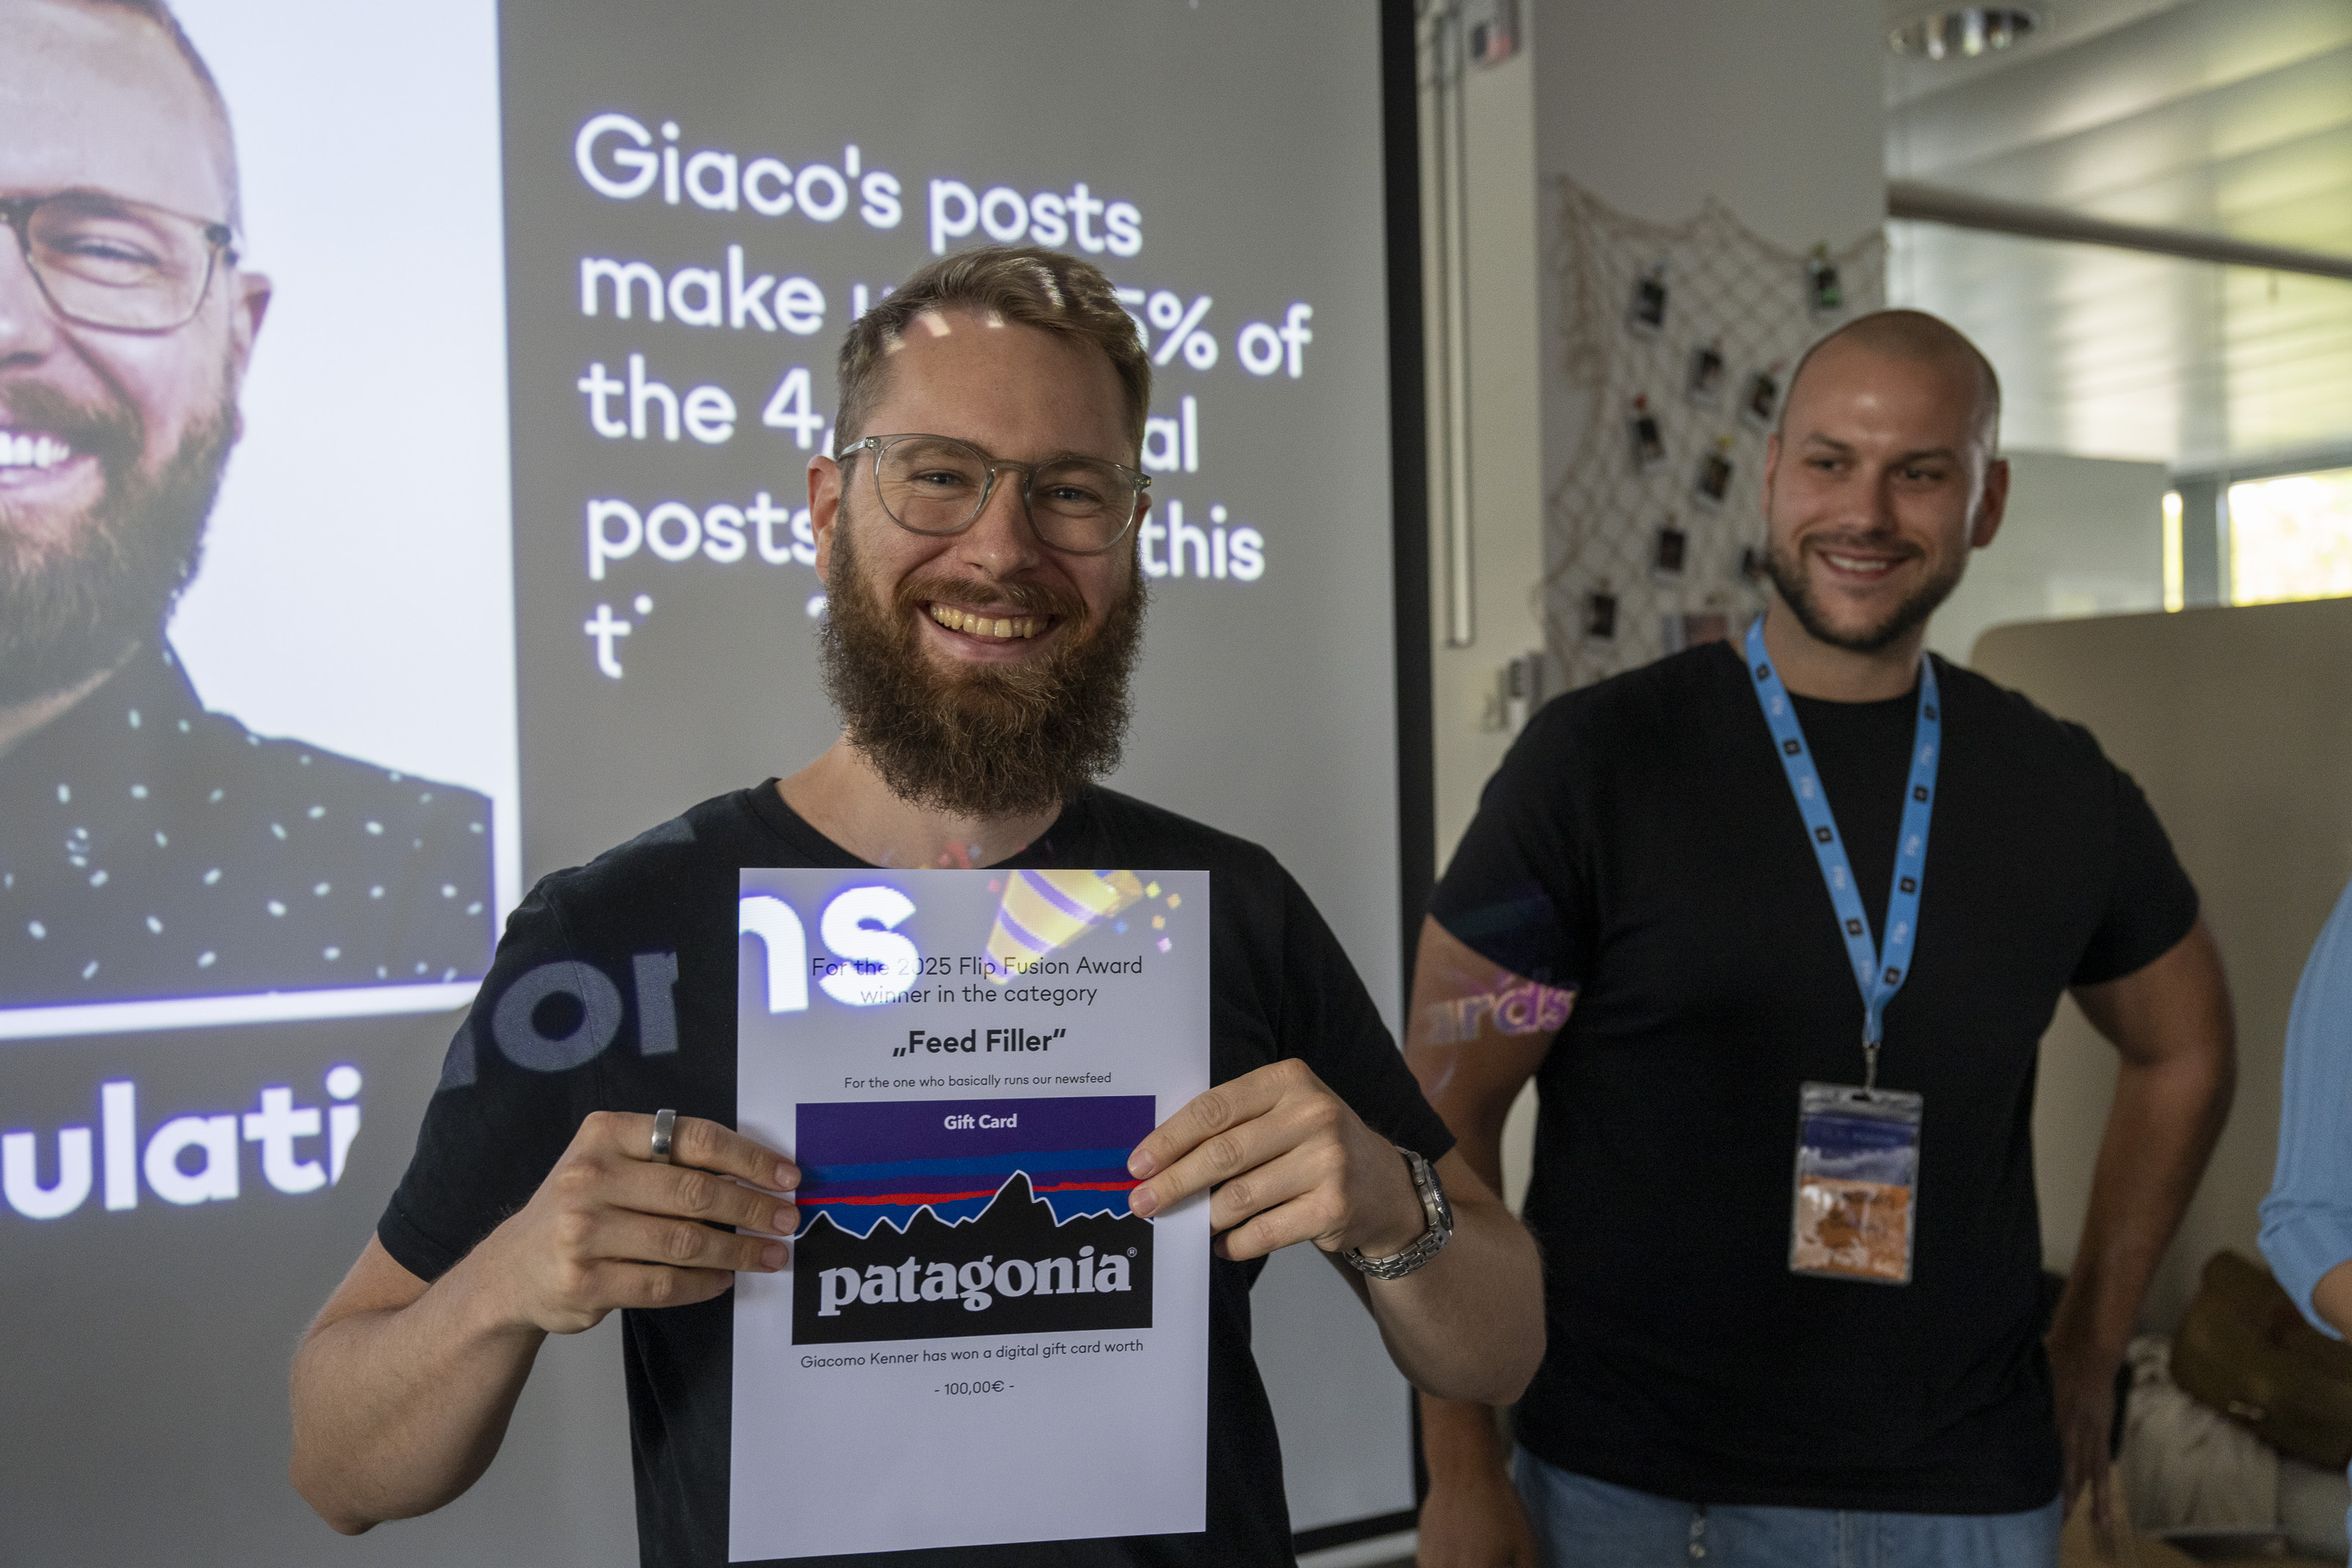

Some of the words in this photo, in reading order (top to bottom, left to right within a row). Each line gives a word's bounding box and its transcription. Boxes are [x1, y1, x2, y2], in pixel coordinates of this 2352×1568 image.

[574, 112, 904, 230] Giaco's
[928, 178, 1144, 258] posts
[579, 243, 827, 336] make
[1237, 302, 1314, 379] of
[577, 353, 736, 444] the
[586, 491, 818, 582] posts
[1139, 499, 1266, 582] this
[812, 957, 848, 976] For
[853, 957, 890, 976] the
[959, 956, 996, 980] Flip
[1003, 956, 1070, 975] Fusion
[1076, 955, 1143, 975] Award
[860, 984, 931, 1003] winner
[938, 984, 955, 1002] in
[961, 983, 997, 1002] the
[1004, 985, 1098, 1007] category
[844, 1076, 865, 1089] For
[869, 1075, 890, 1089] the
[893, 1077, 916, 1088] one
[919, 1075, 945, 1088] who
[948, 1073, 1001, 1088] basically
[1004, 1075, 1030, 1085] runs
[1032, 1075, 1052, 1085] our
[1055, 1072, 1112, 1084] newsfeed
[943, 1114, 976, 1130] Gift
[979, 1113, 1018, 1129] Card
[800, 1354, 866, 1369] Giacomo
[870, 1351, 919, 1366] Kenner
[922, 1349, 948, 1363] has
[950, 1348, 980, 1361] won
[982, 1347, 992, 1359] a
[995, 1342, 1040, 1361] digital
[1042, 1341, 1068, 1359] gift
[1070, 1340, 1101, 1355] card
[1104, 1338, 1144, 1353] worth
[944, 1380, 1005, 1396] 100,00€
